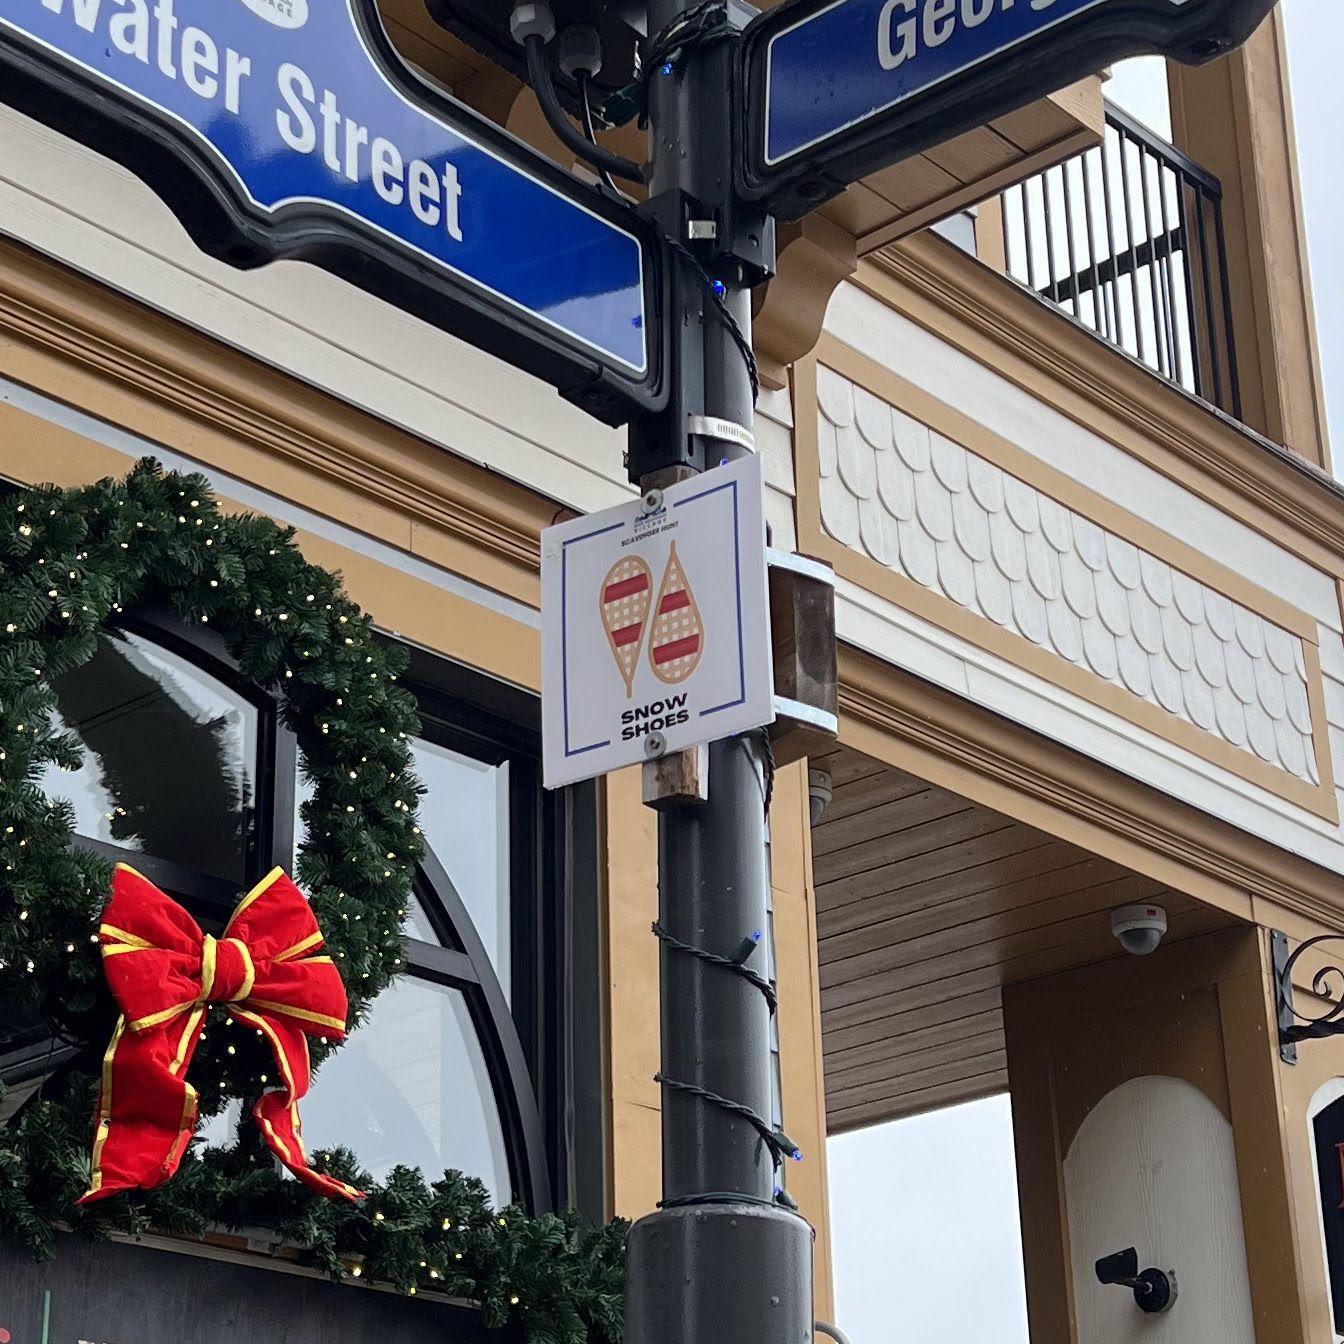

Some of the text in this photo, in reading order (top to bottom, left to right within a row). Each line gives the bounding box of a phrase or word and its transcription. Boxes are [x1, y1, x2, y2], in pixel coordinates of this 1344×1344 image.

[276, 62, 463, 243] Street
[621, 692, 688, 725] SNOW
[621, 709, 690, 741] SHOES
